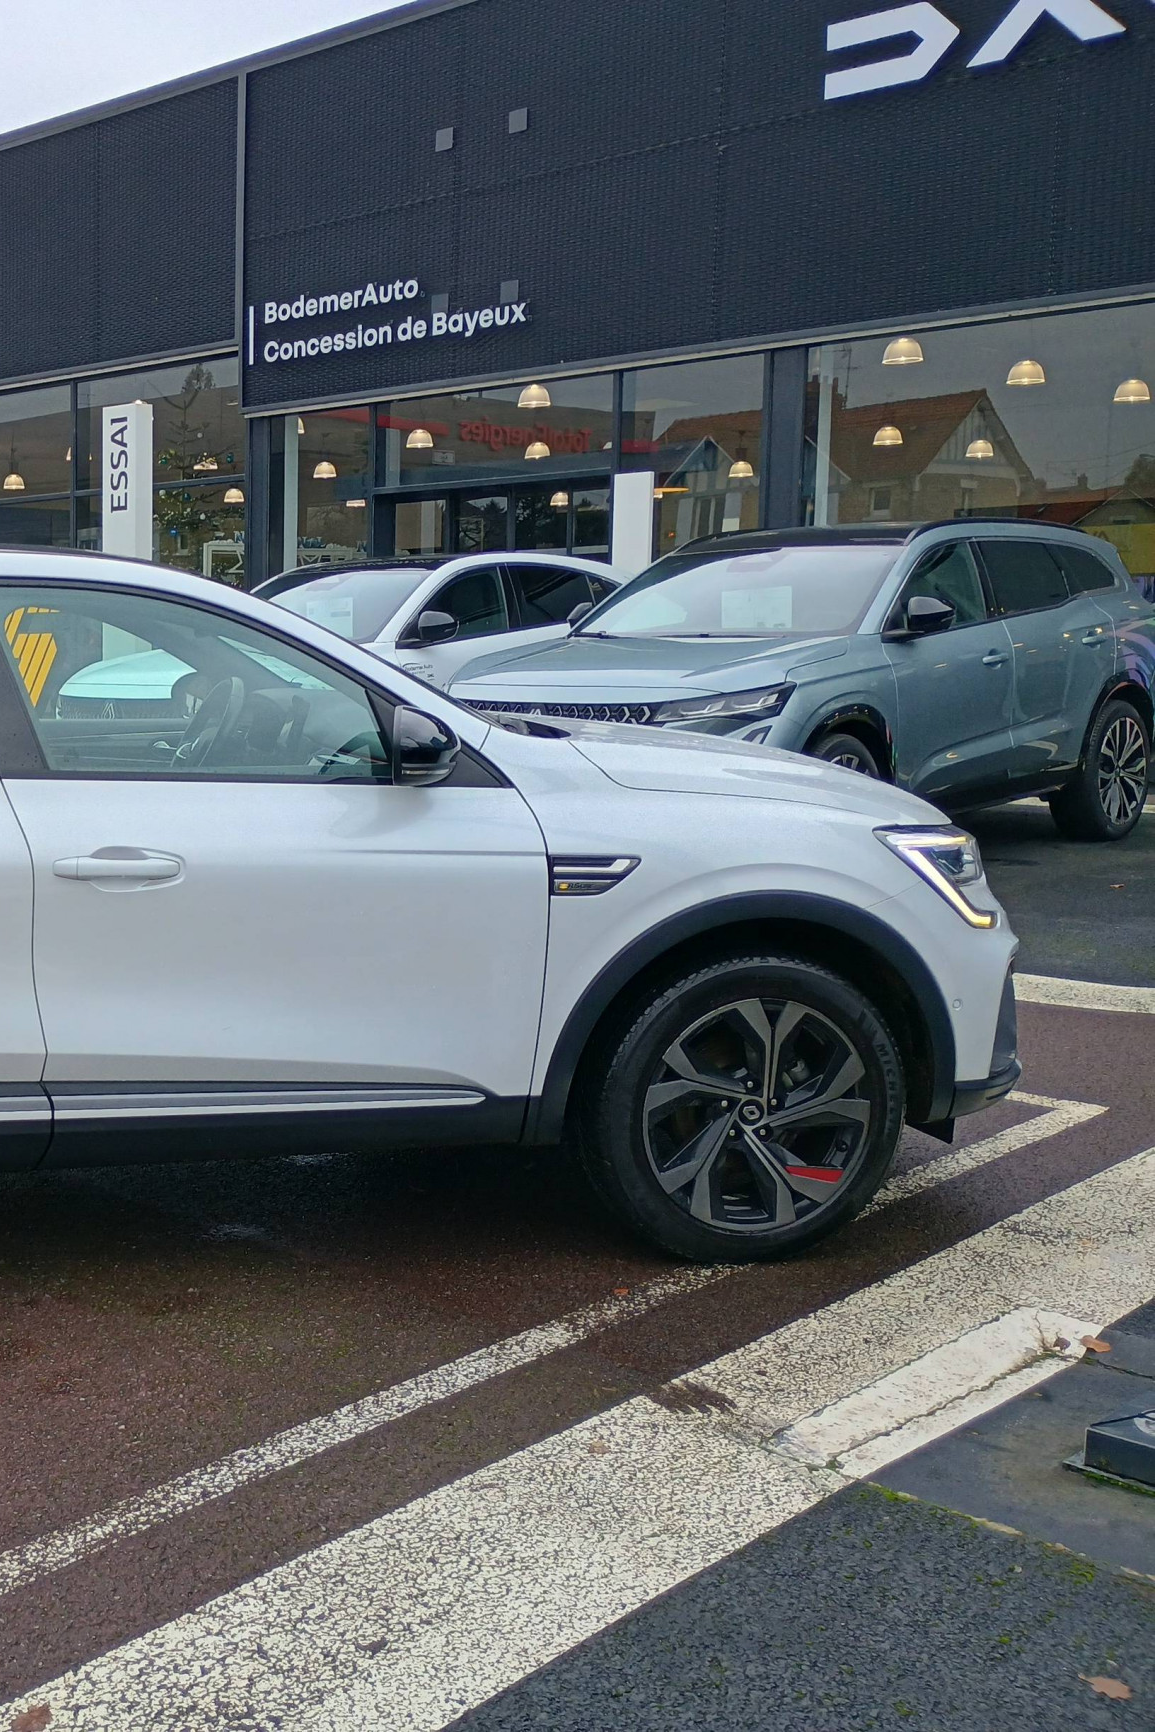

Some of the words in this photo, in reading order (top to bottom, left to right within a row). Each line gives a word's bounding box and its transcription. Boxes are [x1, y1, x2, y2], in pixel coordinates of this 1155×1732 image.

[824, 0, 1155, 100] DA
[264, 279, 419, 324] BodemerAuto
[264, 324, 392, 363] Concession
[397, 316, 427, 341] de
[432, 302, 527, 338] Bayeux
[110, 416, 128, 514] ESSAI
